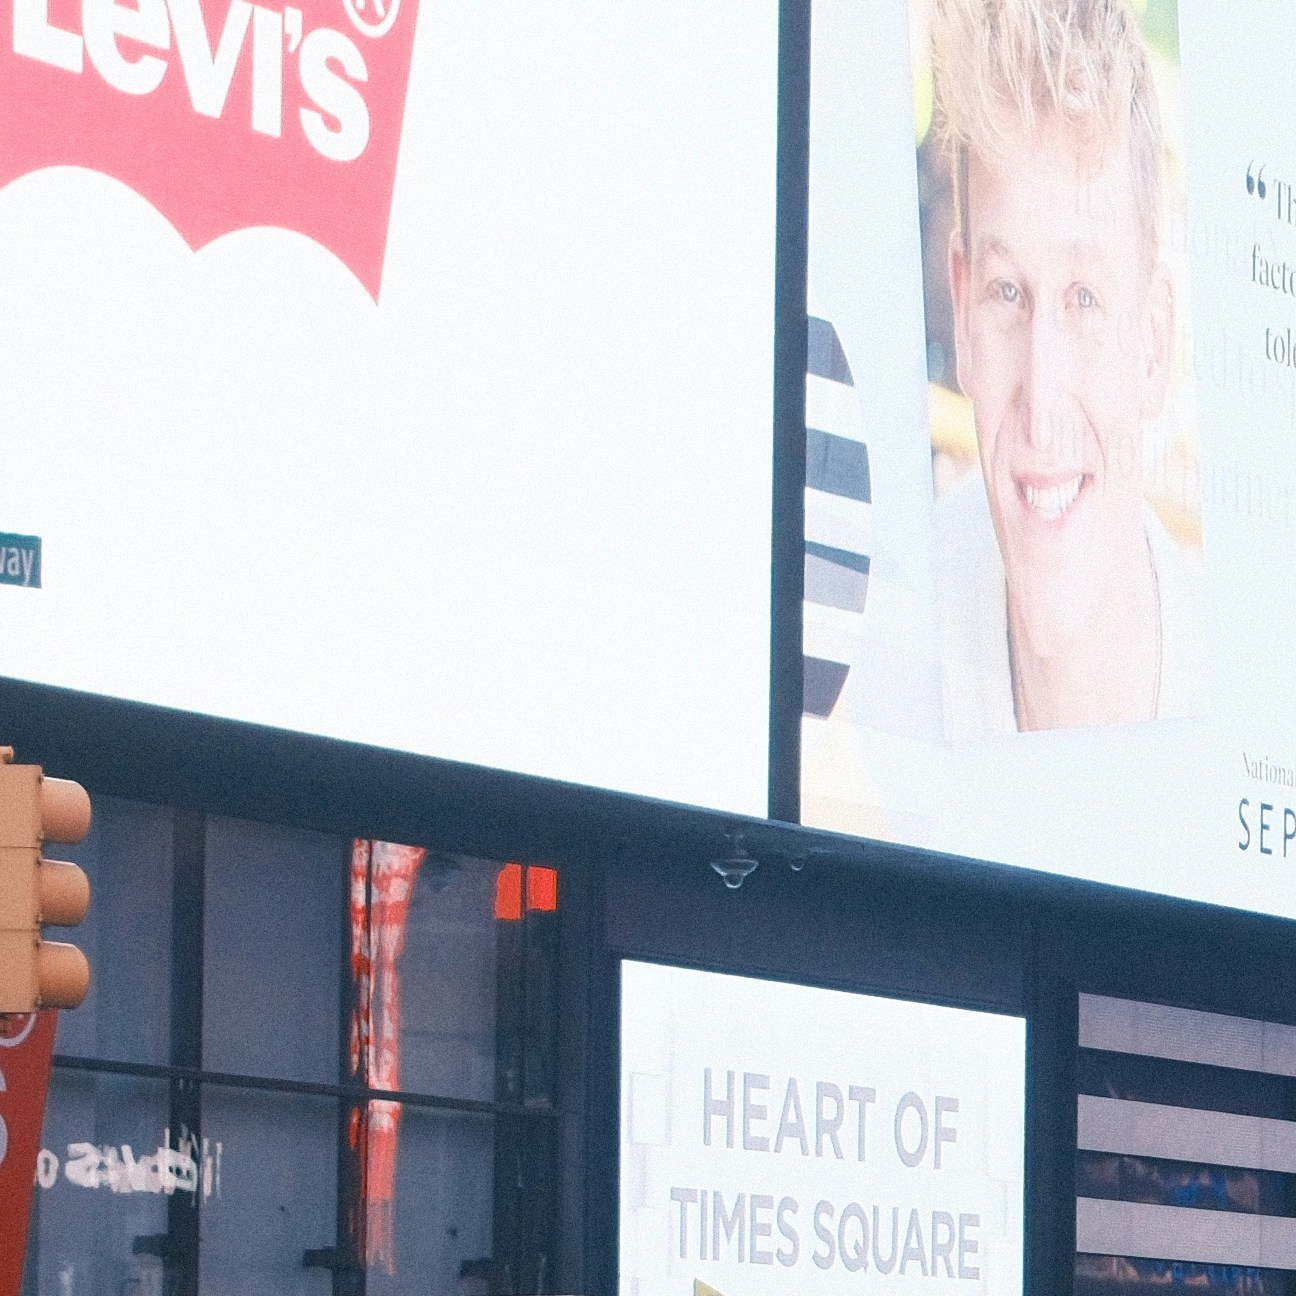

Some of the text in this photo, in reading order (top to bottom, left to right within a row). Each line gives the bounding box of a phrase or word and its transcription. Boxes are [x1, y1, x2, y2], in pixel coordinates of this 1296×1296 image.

[703, 1066, 960, 1170] HEART OF
[670, 1186, 982, 1281] TIMES SQUARE
